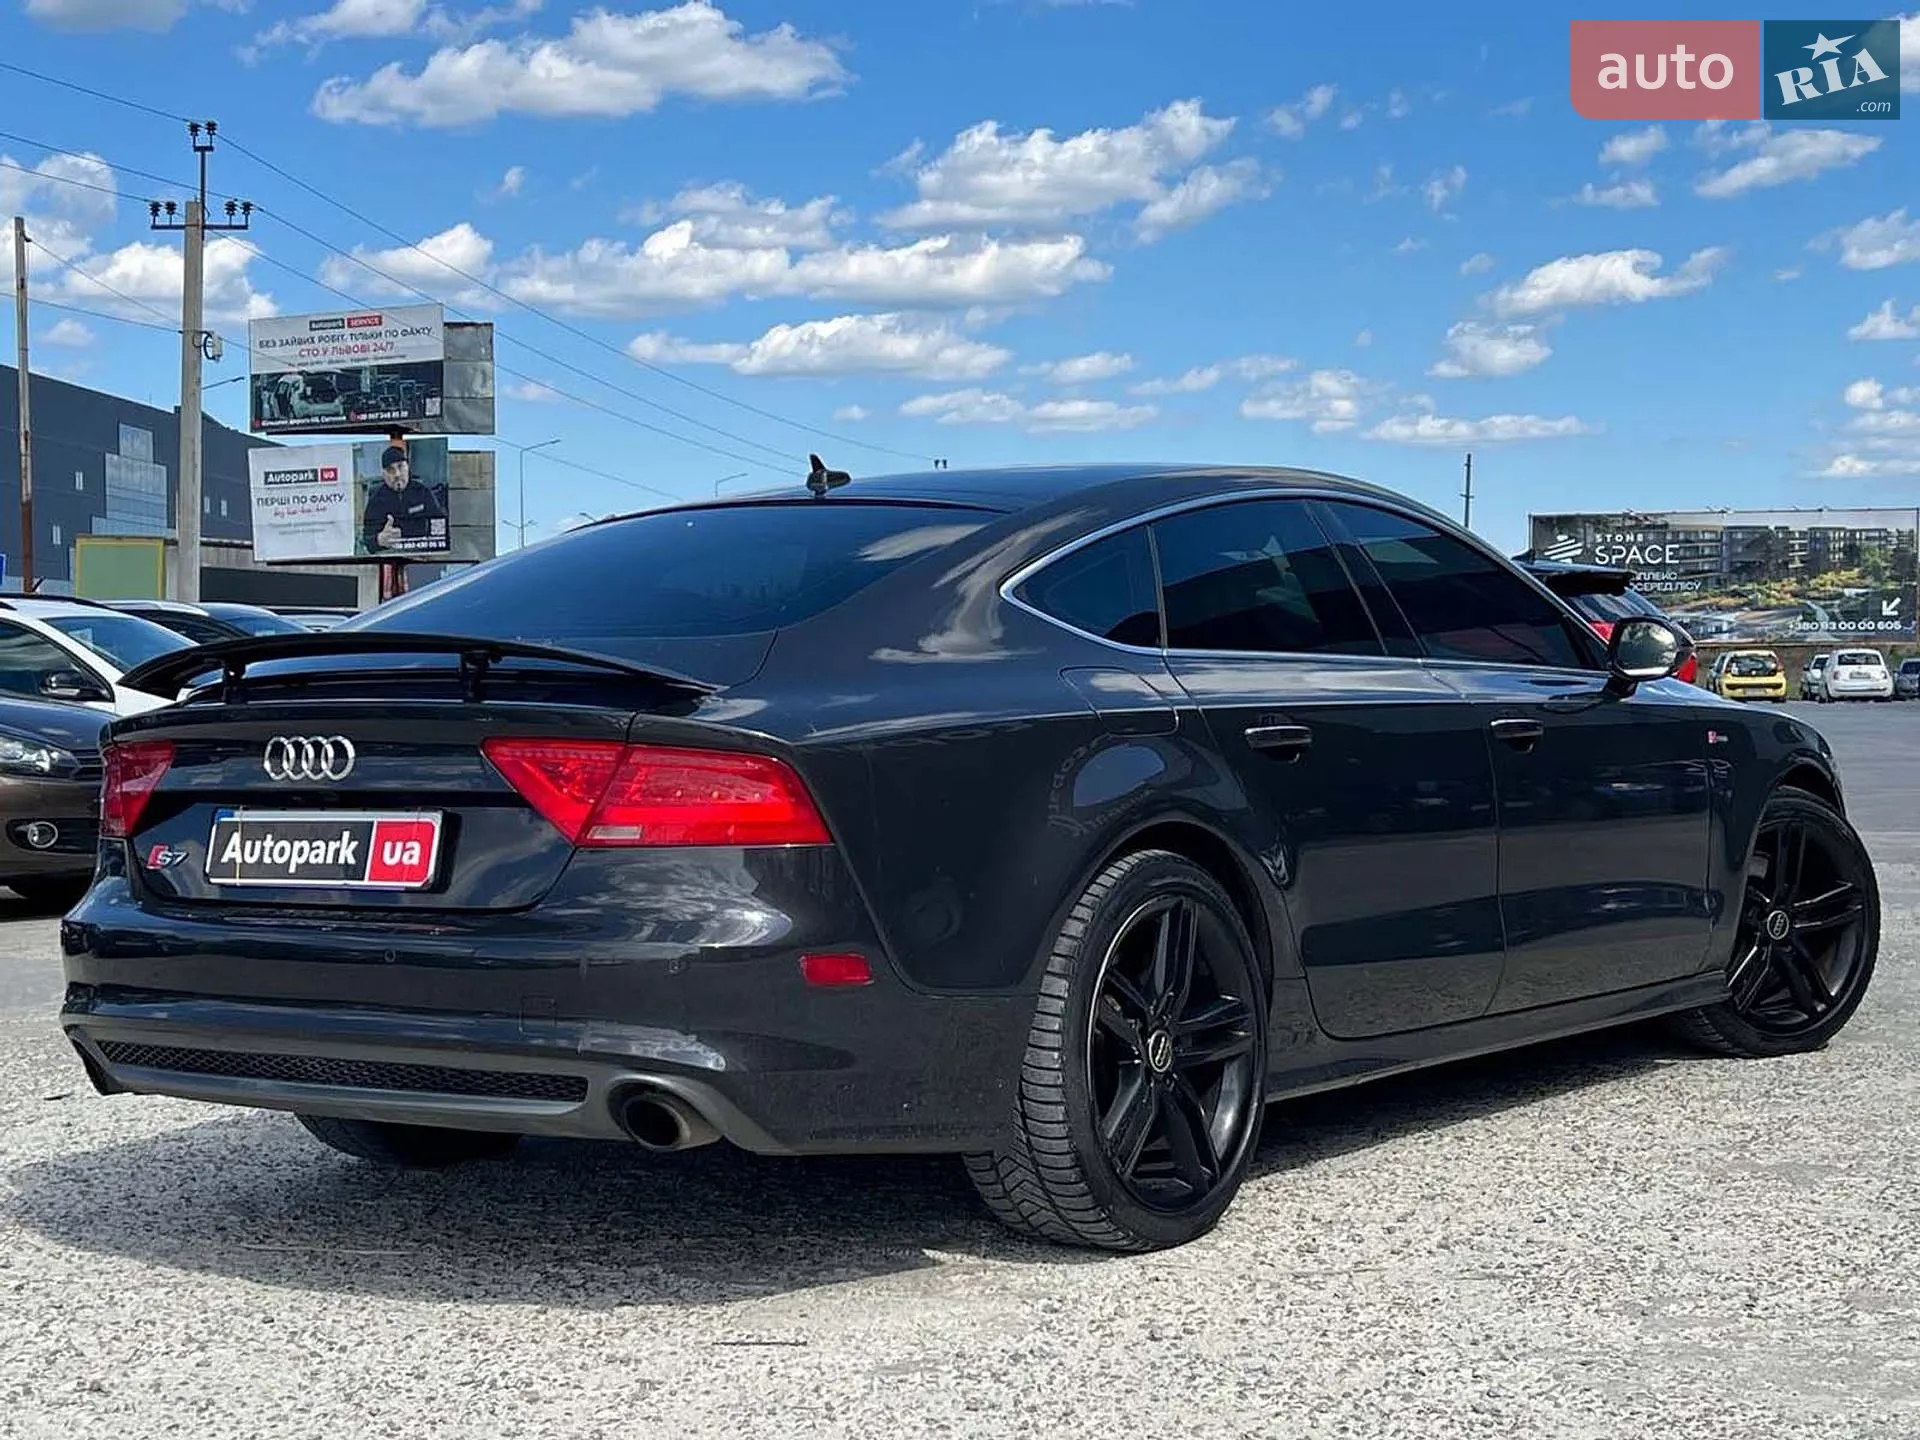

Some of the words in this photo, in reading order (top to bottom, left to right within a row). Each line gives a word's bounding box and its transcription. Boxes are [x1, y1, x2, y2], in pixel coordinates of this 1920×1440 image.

[259, 339, 277, 348] БЕЗ
[280, 335, 315, 347] ЗАЙВИХ
[385, 329, 399, 338] ПО
[299, 347, 320, 357] СТО
[322, 346, 329, 355] У
[332, 343, 370, 355] ЛЬВОВІ
[372, 341, 395, 352] 24/7
[267, 470, 316, 483] Autopark
[322, 471, 336, 480] ua
[257, 496, 290, 507] ПЕРШІ
[293, 494, 308, 505] ПО
[1595, 544, 1680, 565] SPACE
[1675, 581, 1701, 591] ЛІСУ
[1838, 620, 1856, 631] 00
[1877, 620, 1902, 631] 605
[154, 849, 188, 867] S7
[221, 830, 359, 875] Autopark
[382, 839, 421, 866] ua
